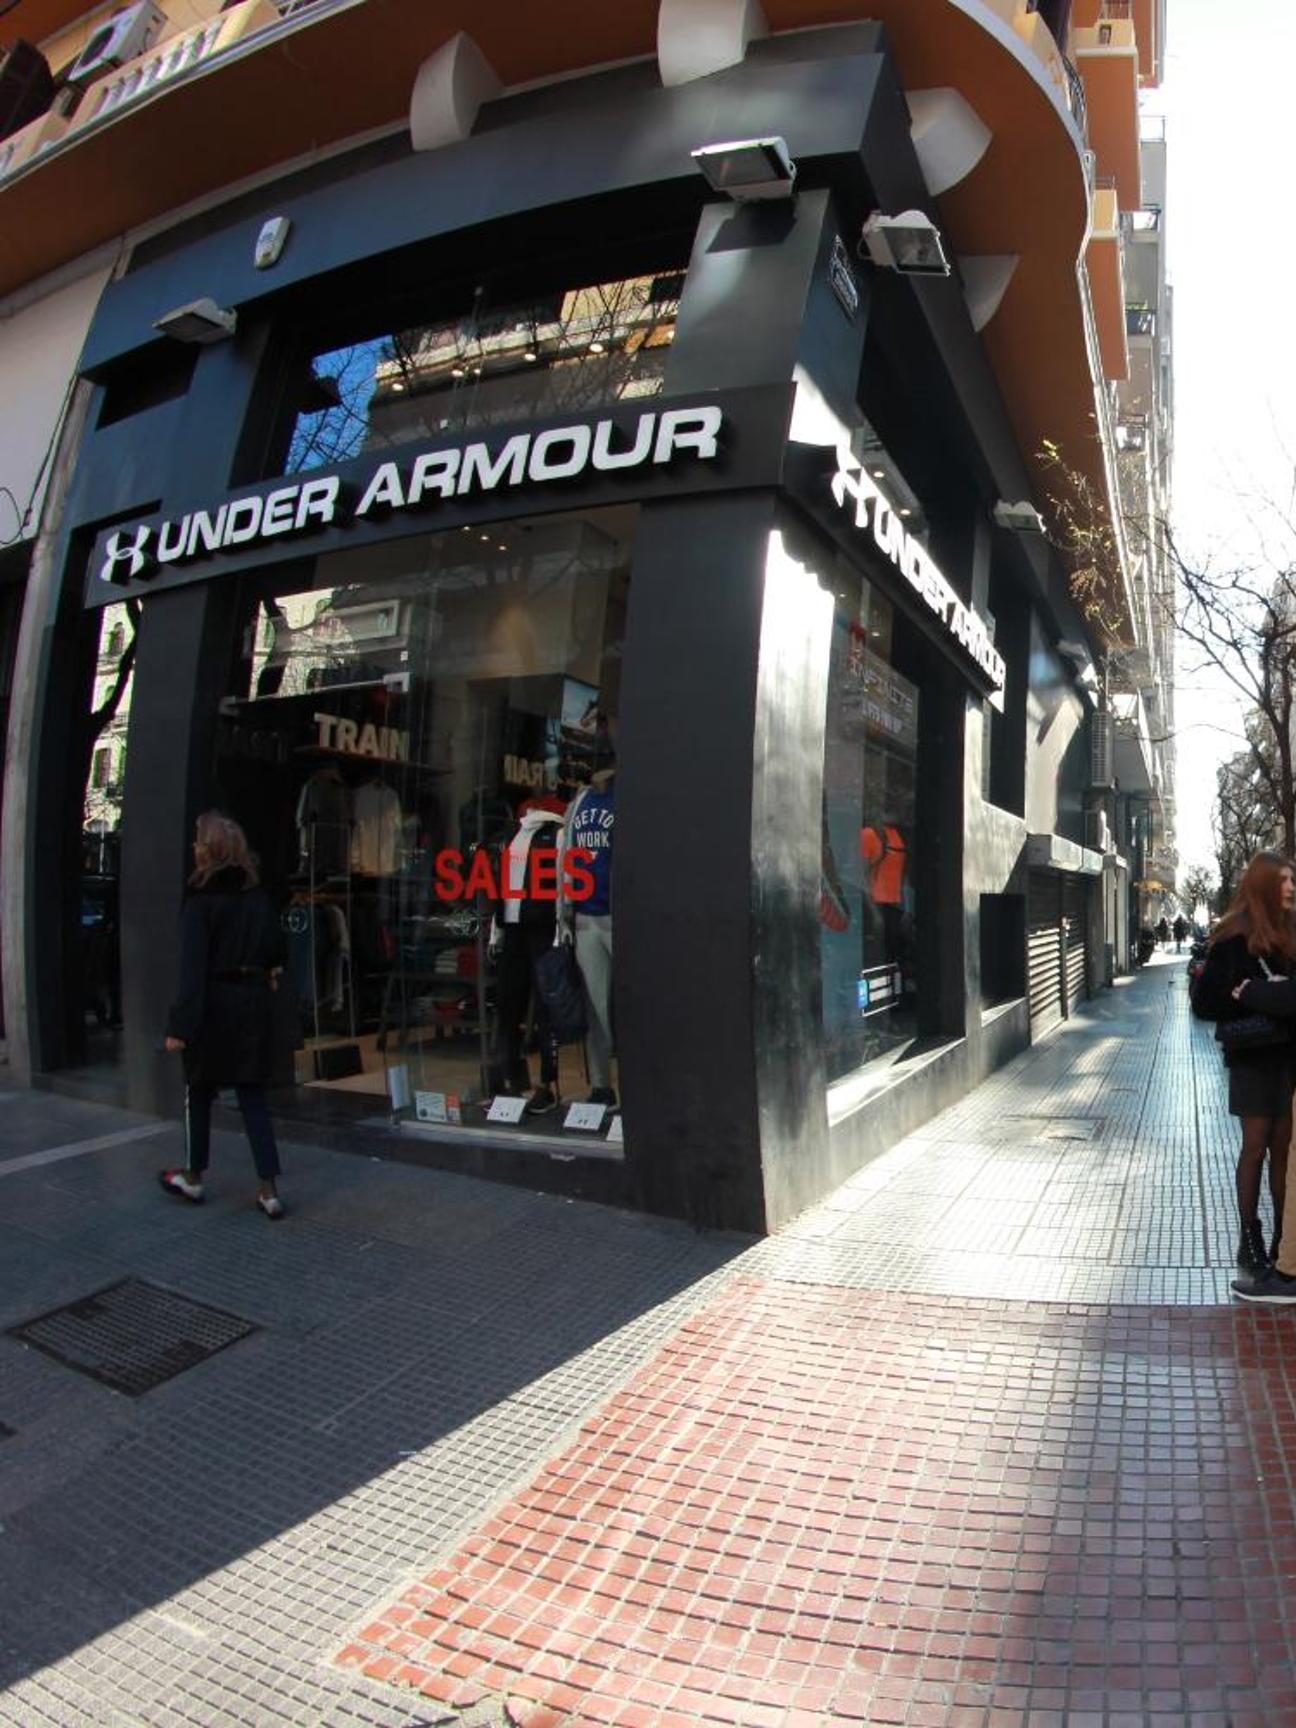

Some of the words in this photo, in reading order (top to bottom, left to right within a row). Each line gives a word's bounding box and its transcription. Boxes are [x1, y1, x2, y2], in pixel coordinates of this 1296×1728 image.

[156, 475, 341, 564] UNDER
[354, 404, 723, 517] ARMOUR
[313, 712, 410, 761] TRAIN
[575, 831, 611, 849] WORK
[597, 808, 615, 829] TO
[433, 847, 597, 902] SALES
